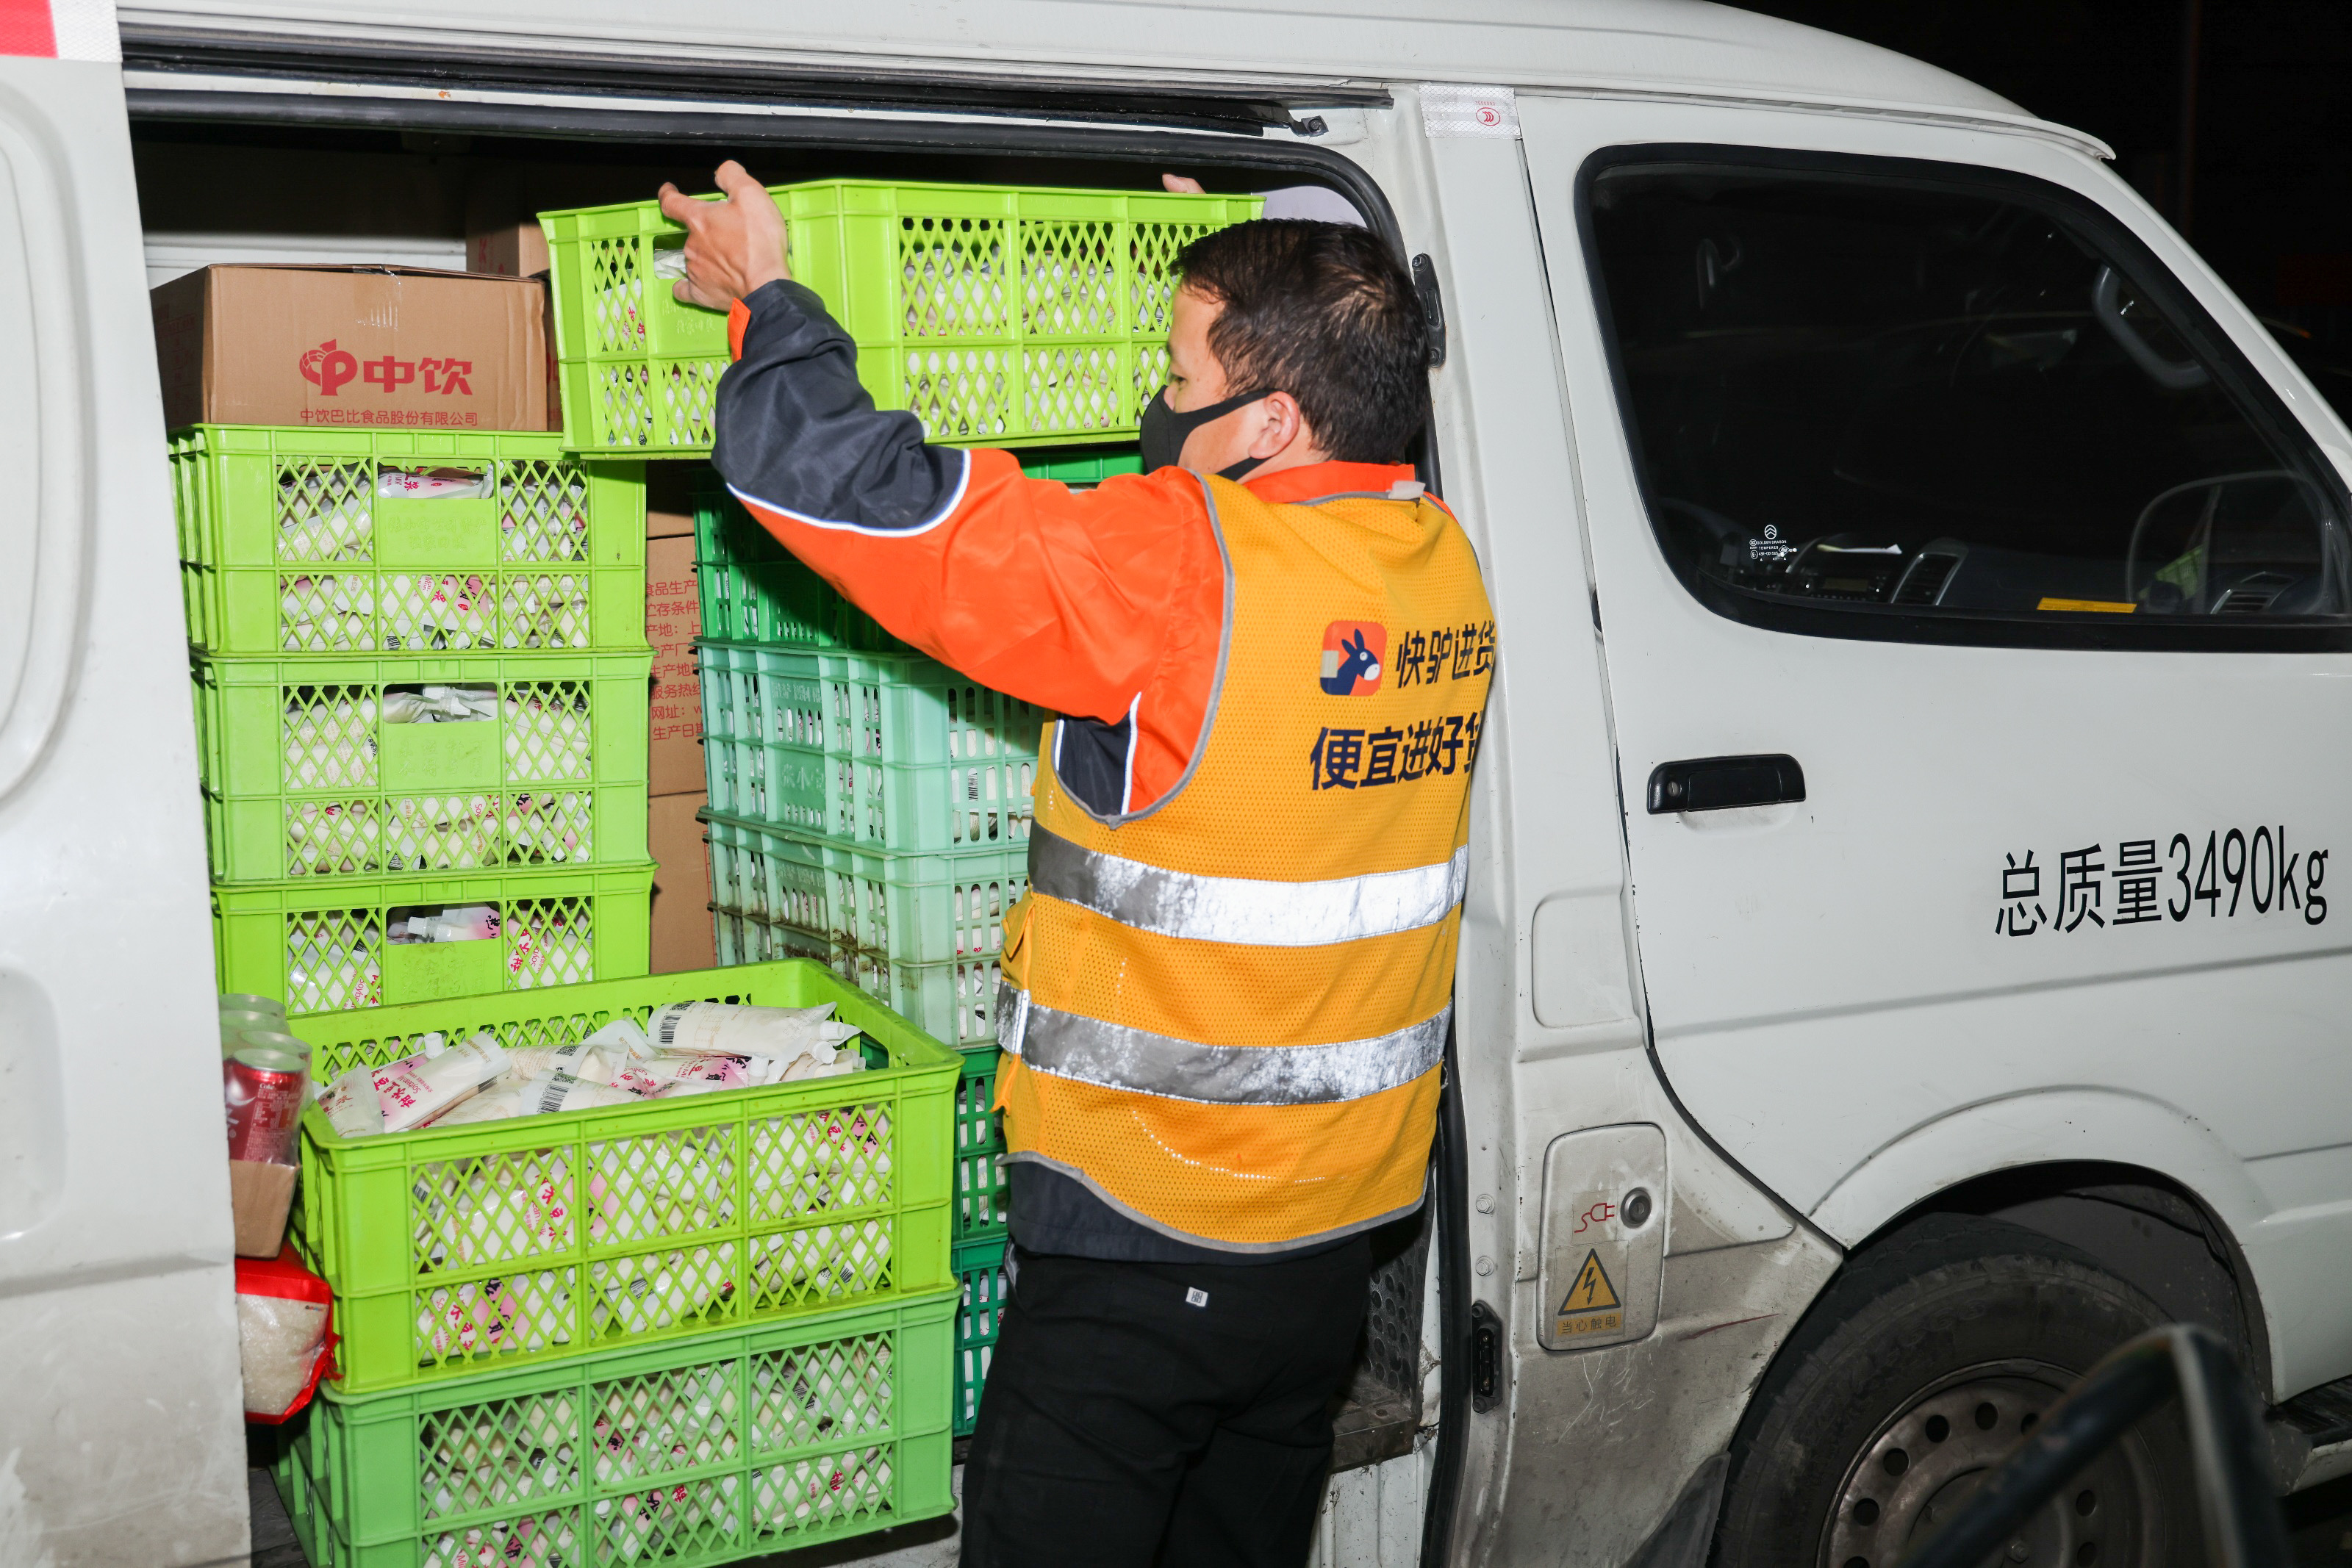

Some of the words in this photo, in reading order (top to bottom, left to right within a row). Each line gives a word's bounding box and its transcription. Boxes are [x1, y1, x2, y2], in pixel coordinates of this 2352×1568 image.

[363, 356, 473, 395] 中饮
[300, 408, 478, 426] 中饮巴比食品股份有限公司
[1396, 620, 1495, 688] 快驴进货
[1561, 1315, 1616, 1334] 当心触电
